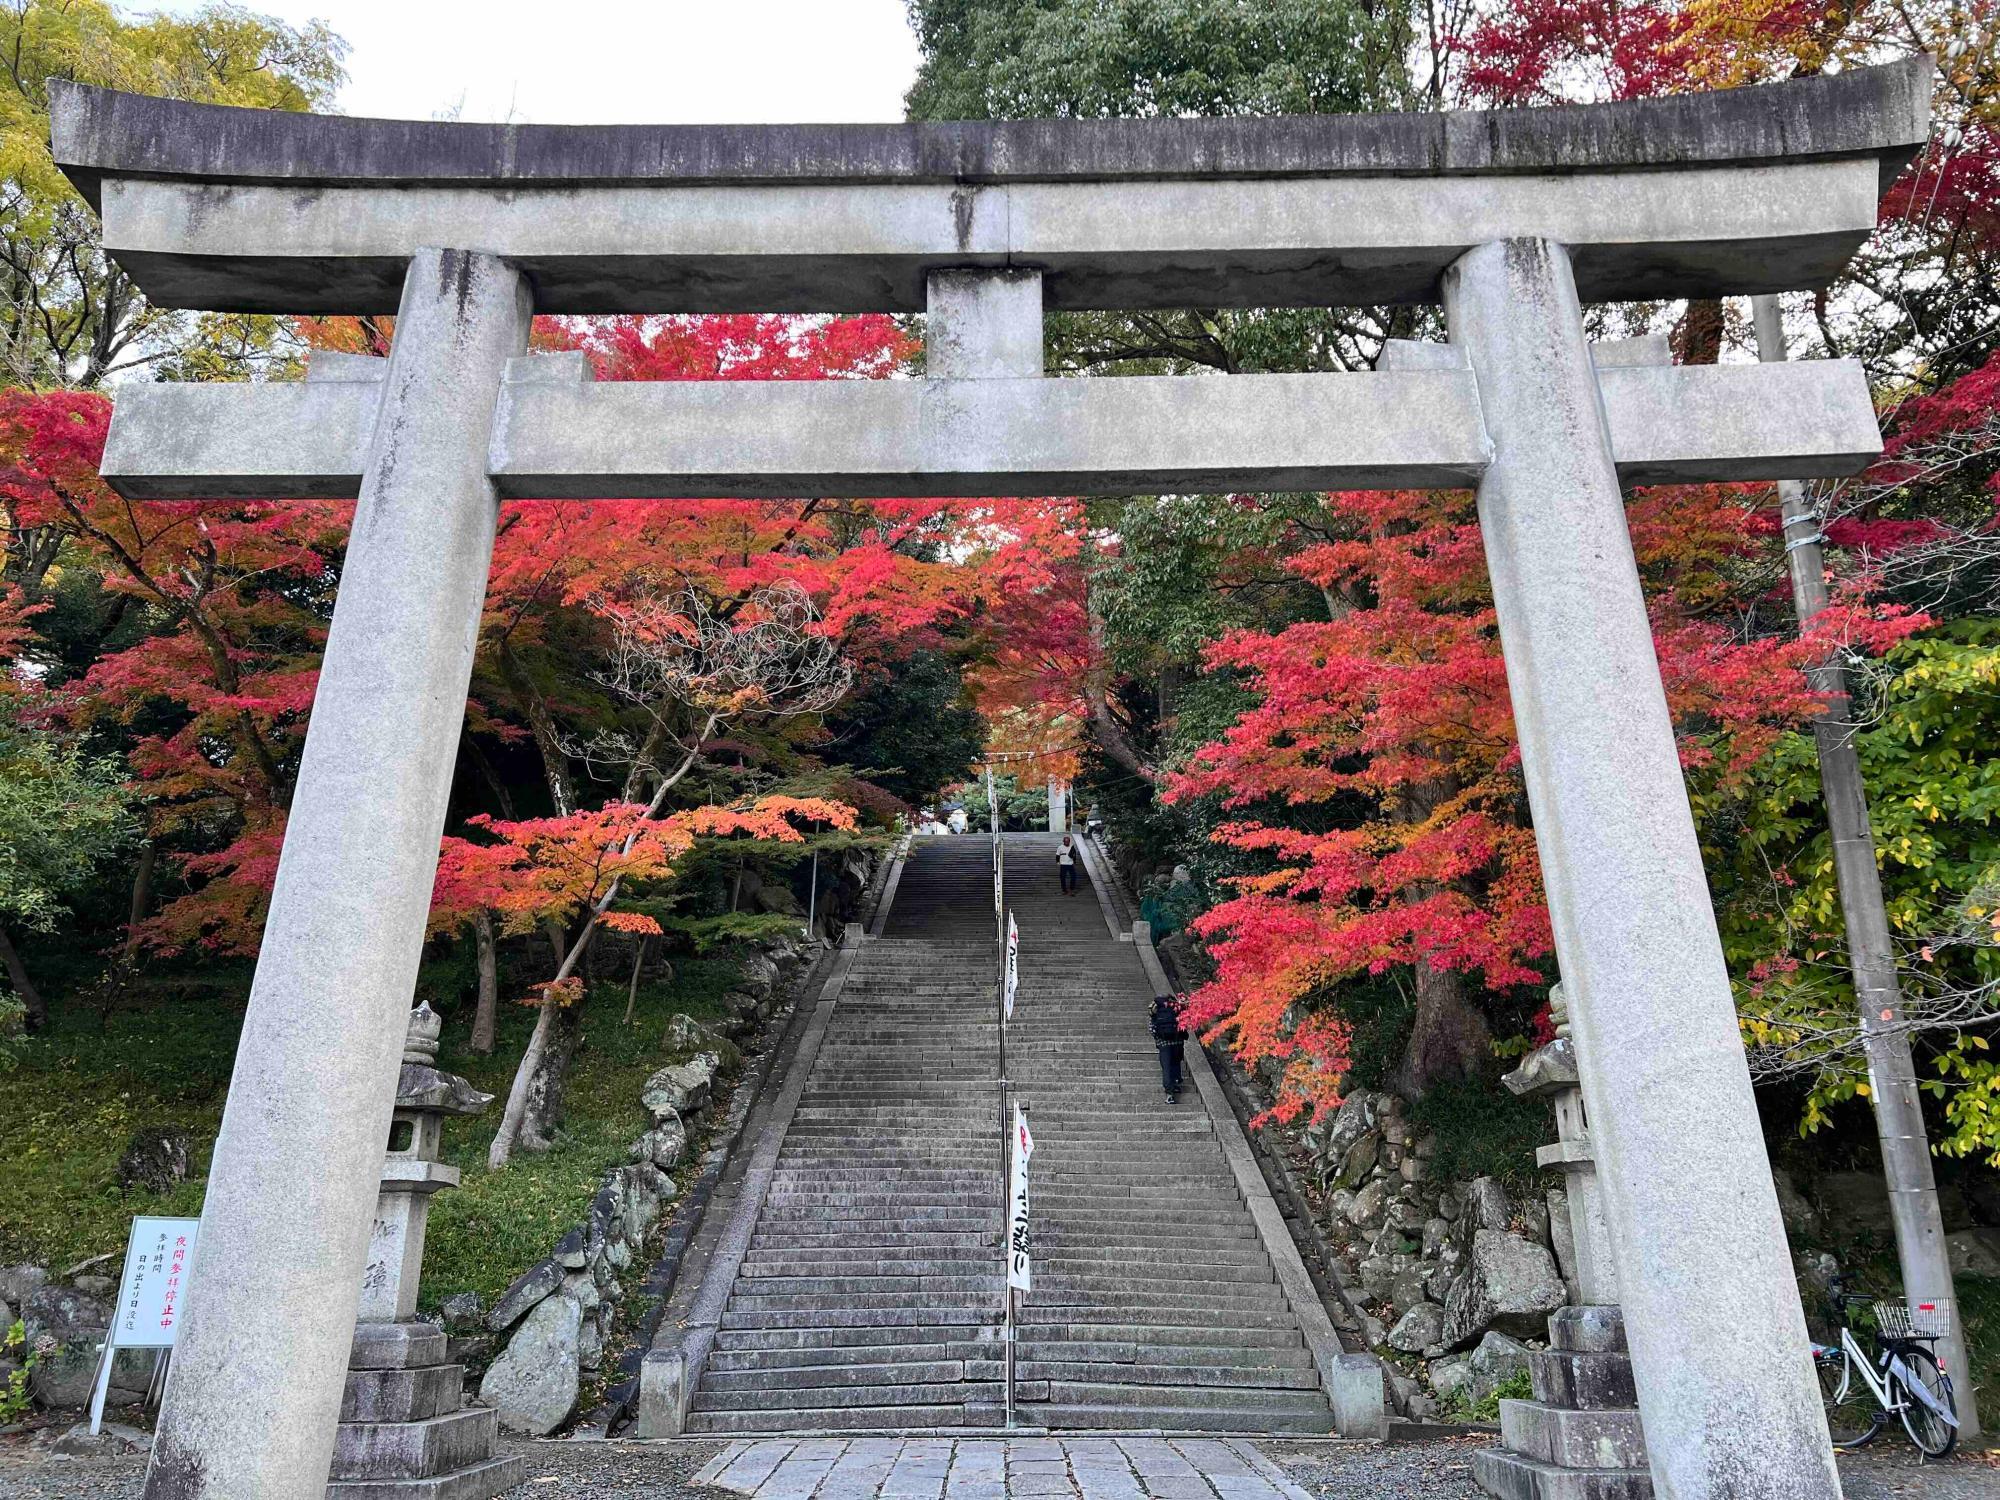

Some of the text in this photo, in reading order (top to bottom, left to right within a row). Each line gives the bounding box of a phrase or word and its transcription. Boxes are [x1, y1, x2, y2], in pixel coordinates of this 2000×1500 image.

[152, 1232, 168, 1273] 参拝時間
[160, 1235, 187, 1330] 夜間参拝停止中
